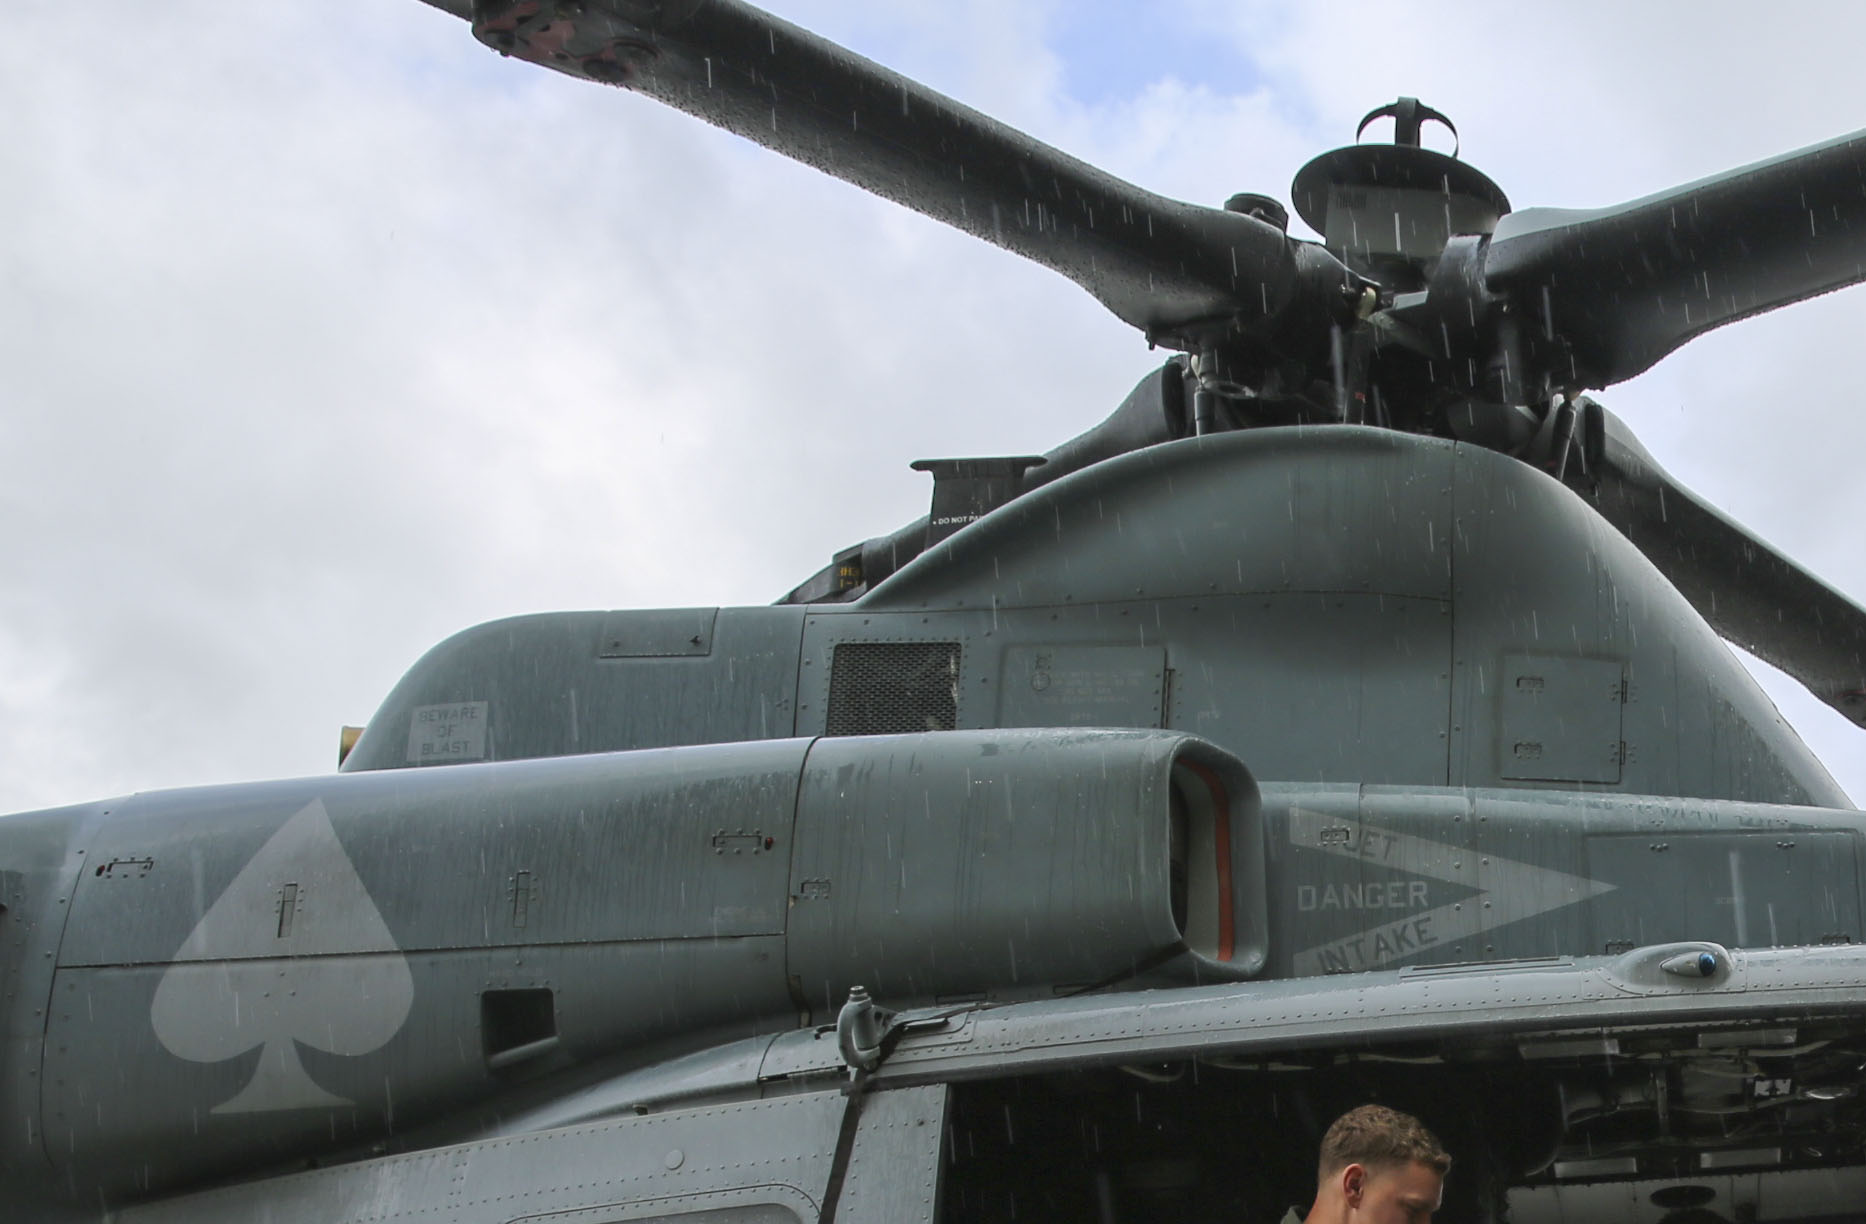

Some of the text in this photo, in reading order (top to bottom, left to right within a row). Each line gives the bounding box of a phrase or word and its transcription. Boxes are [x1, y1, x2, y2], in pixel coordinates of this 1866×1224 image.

[938, 517, 950, 525] DO
[951, 516, 967, 524] NOT
[419, 707, 479, 721] BEWARE
[438, 724, 457, 738] OF
[422, 741, 470, 755] BLAST
[1343, 829, 1397, 860] JET
[1297, 880, 1428, 911] DANGER
[1316, 916, 1438, 974] INTAKE
